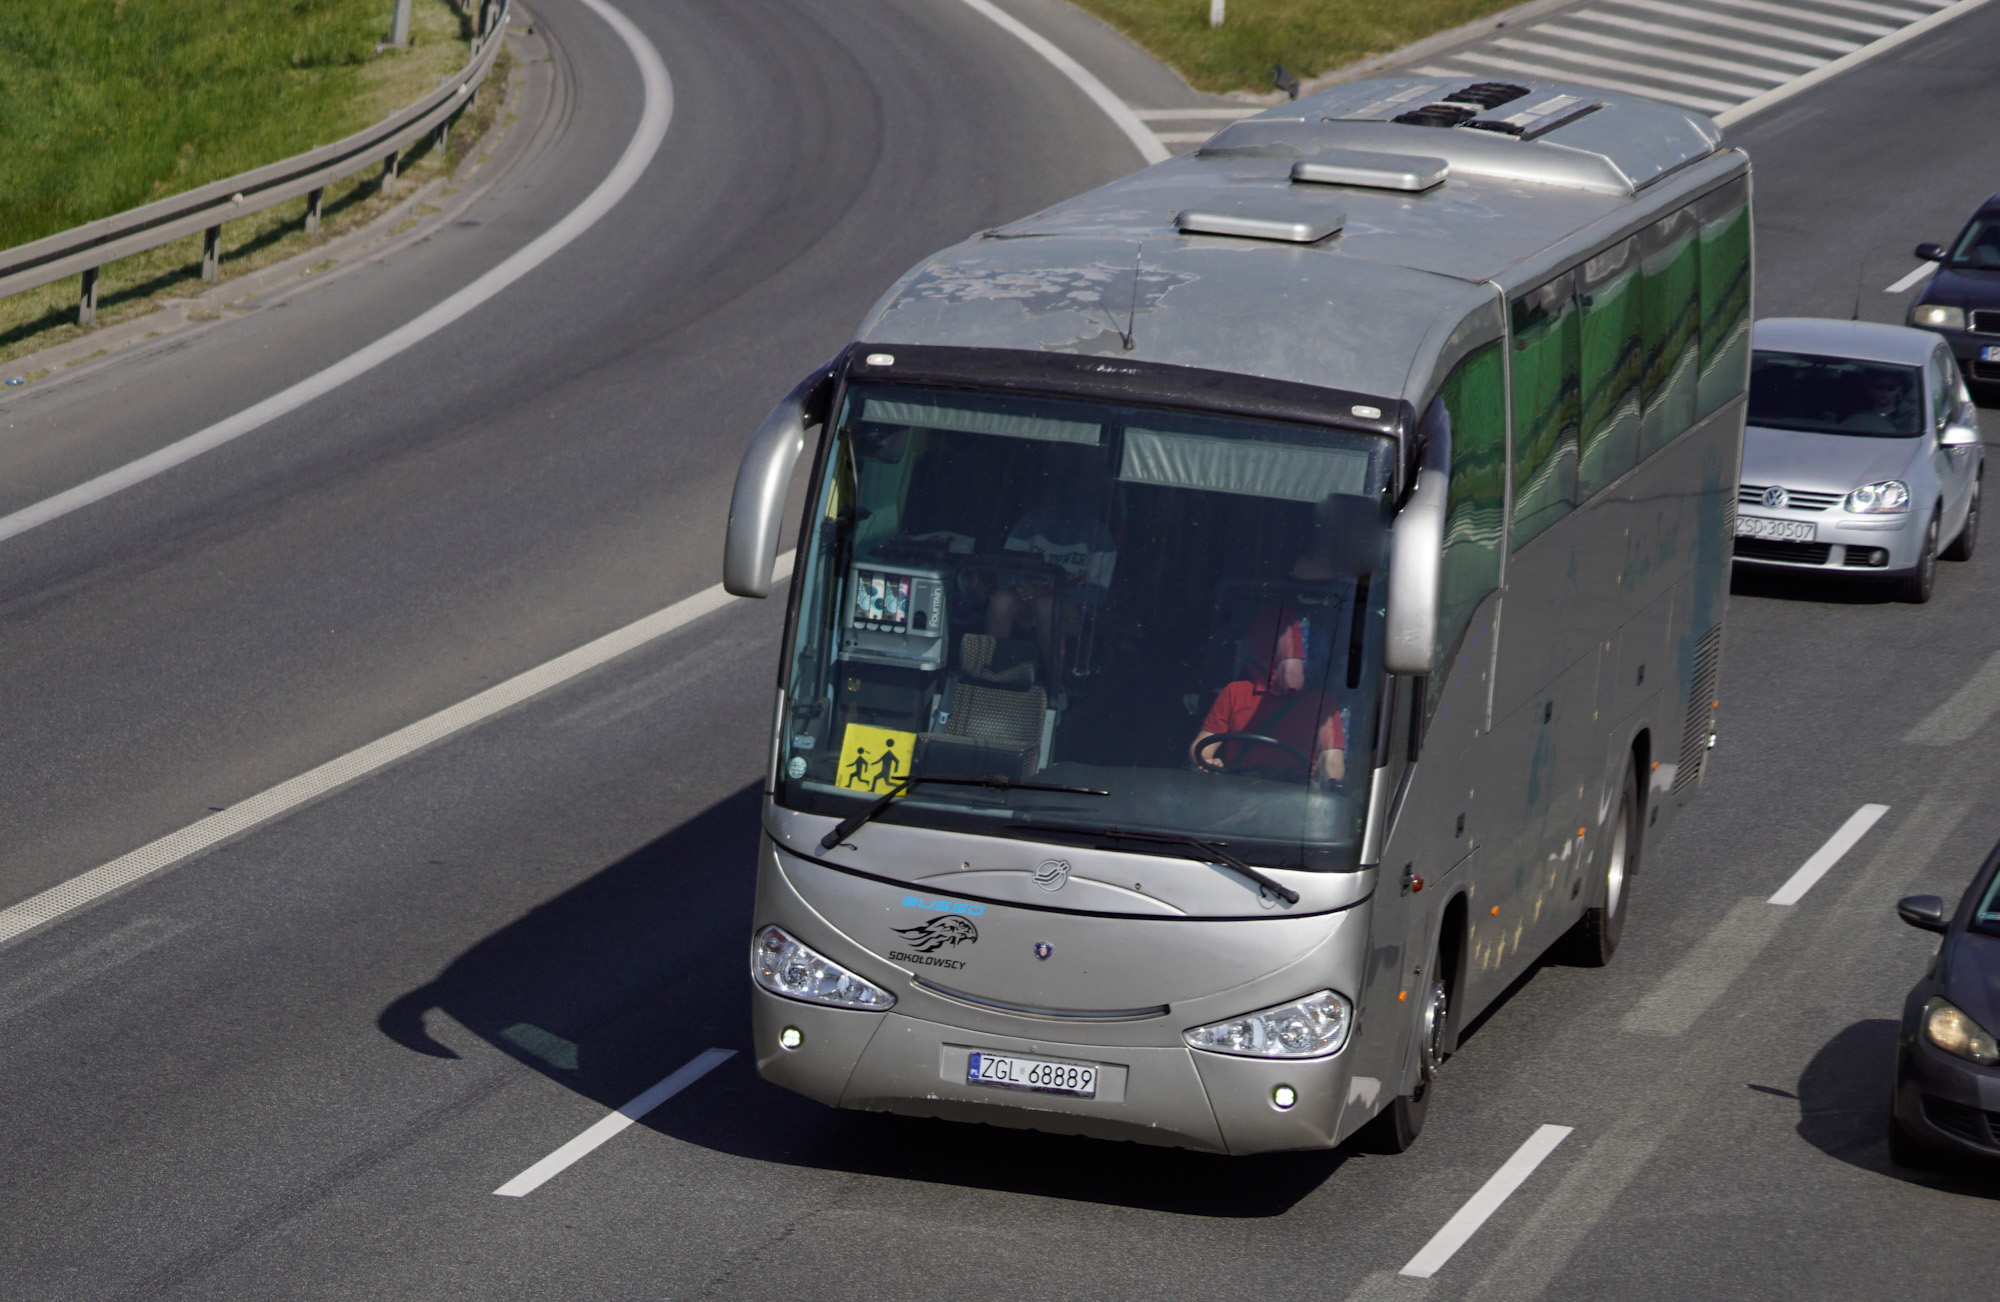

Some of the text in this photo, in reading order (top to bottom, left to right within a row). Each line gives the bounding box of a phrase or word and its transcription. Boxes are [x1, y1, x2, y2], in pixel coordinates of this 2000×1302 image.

[1736, 518, 1813, 539] ZSD 30507
[901, 896, 985, 916] BUSSO
[888, 950, 966, 970] SOKOŁOWSCY
[970, 1068, 979, 1076] PL
[981, 1057, 1092, 1090] ZGL 68889
